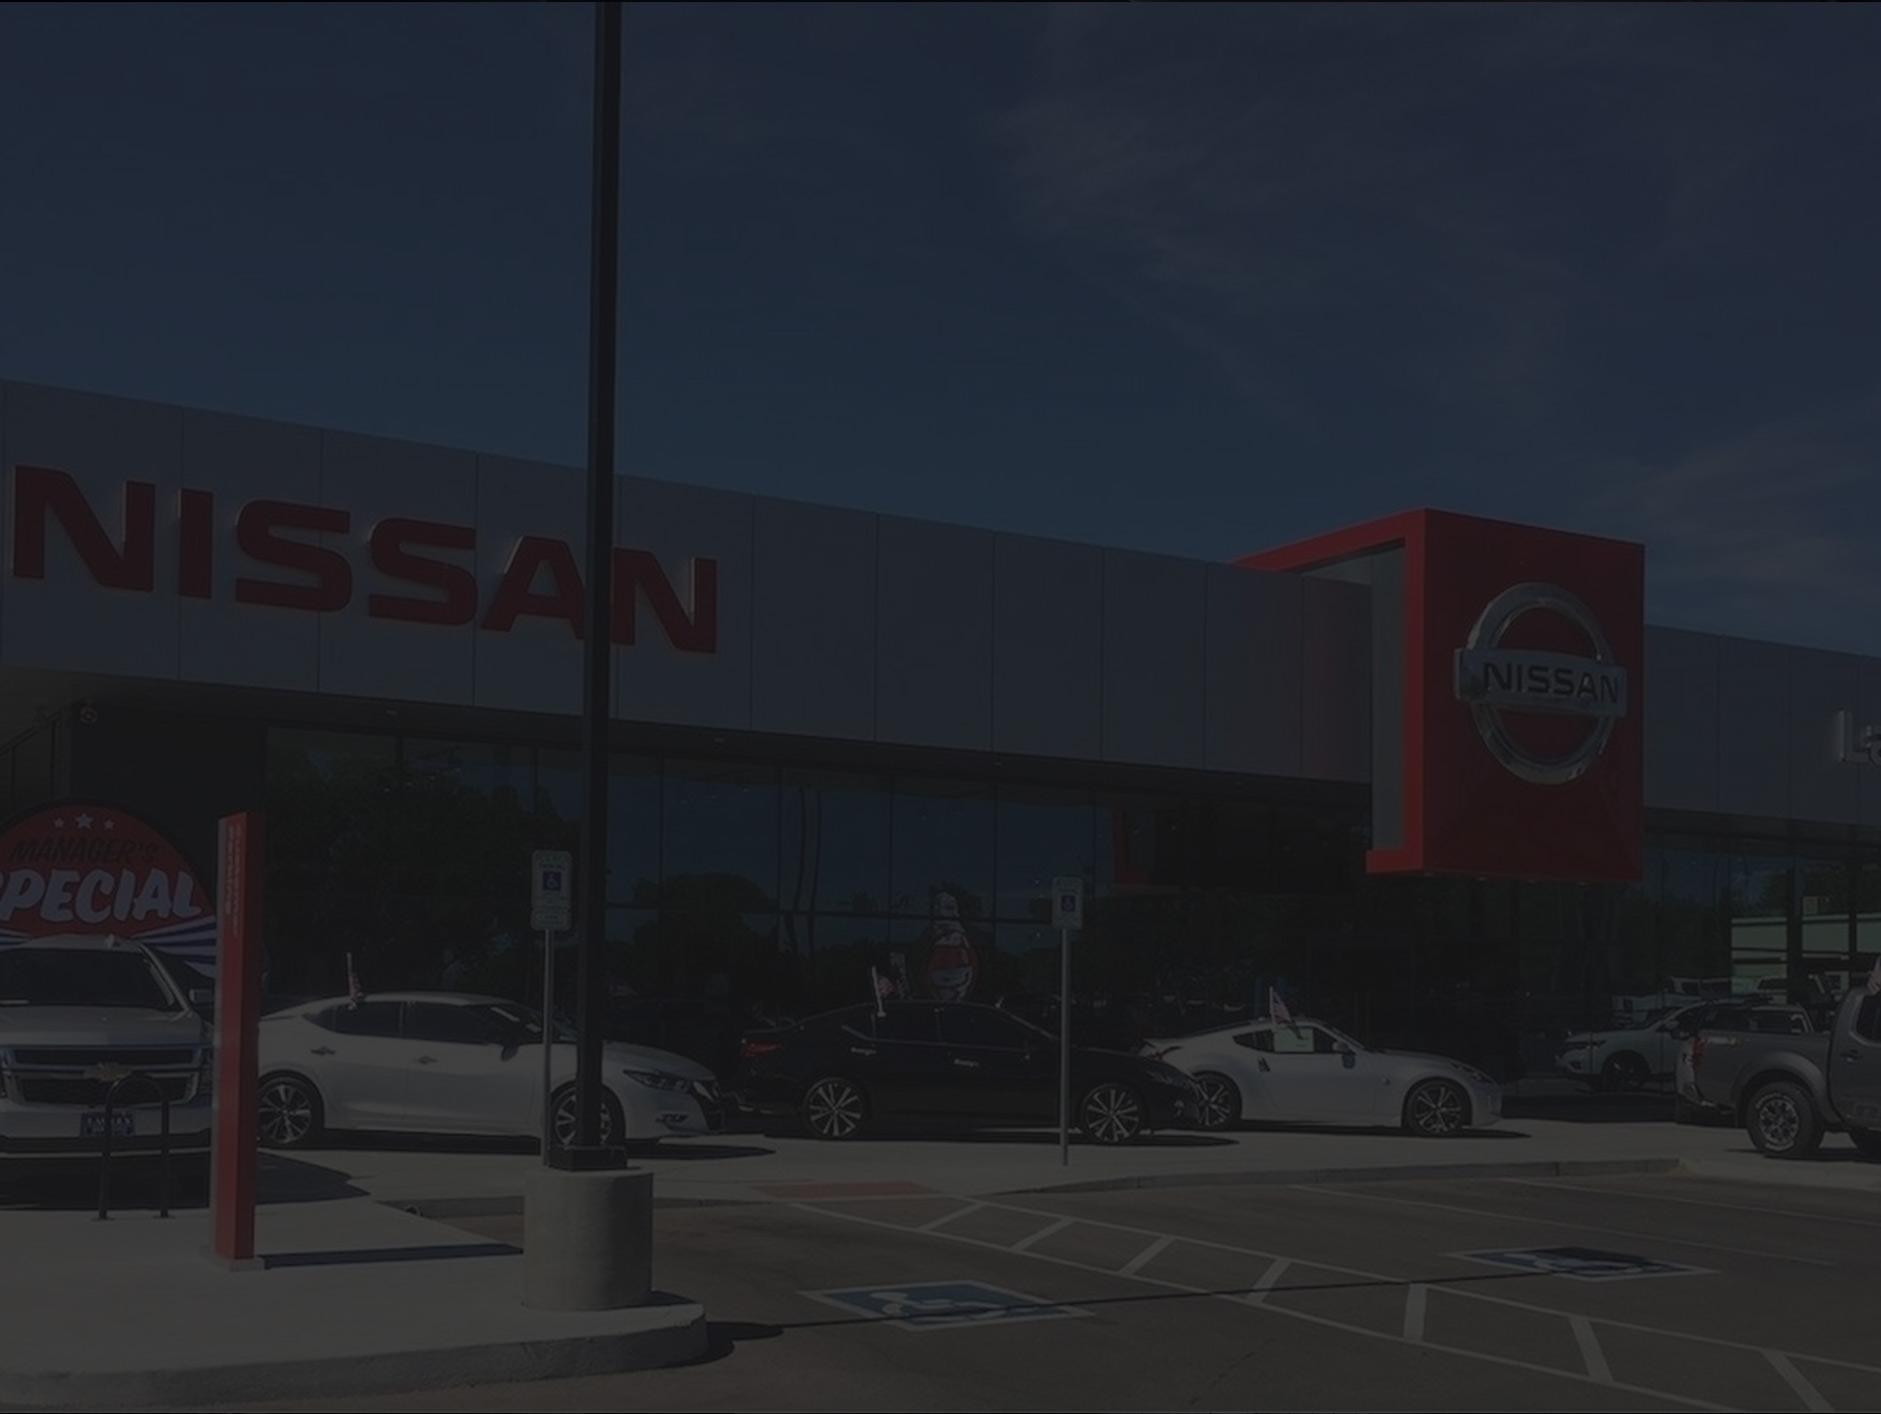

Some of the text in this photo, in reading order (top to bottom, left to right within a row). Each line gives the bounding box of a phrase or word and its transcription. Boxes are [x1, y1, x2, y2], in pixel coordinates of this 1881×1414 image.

[12, 465, 719, 654] NISSAN
[1484, 662, 1618, 703] NISSAN
[9, 836, 159, 864] MANAGER'S
[0, 867, 203, 925] PECIAL
